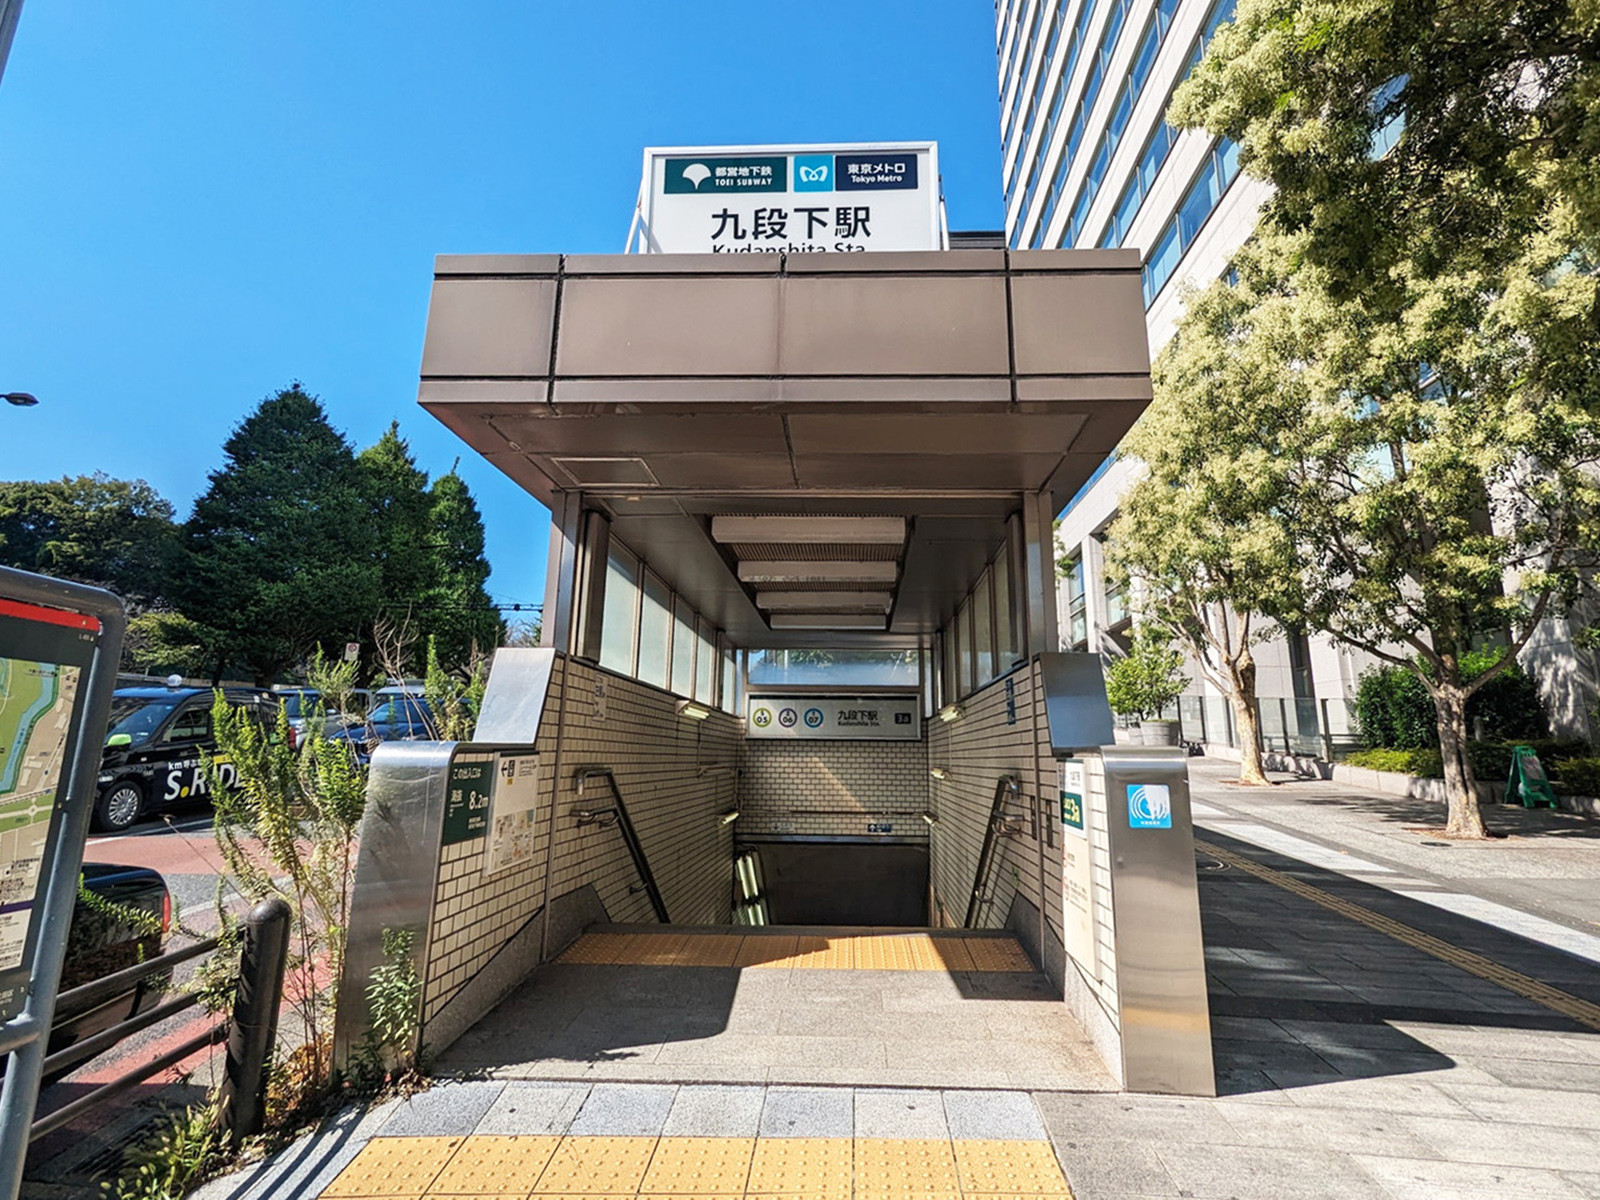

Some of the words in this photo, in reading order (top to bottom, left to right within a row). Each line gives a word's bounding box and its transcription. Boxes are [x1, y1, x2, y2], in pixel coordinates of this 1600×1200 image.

[715, 166, 772, 177] 都営地下鉄
[847, 163, 905, 174] 東京メトロ
[737, 178, 772, 186] SUBWAY
[851, 175, 875, 184] Tokyo
[877, 174, 902, 183] Metro
[711, 206, 871, 240] 九段下駅
[782, 716, 794, 724] 06
[808, 716, 819, 724] 07
[838, 710, 878, 721] 九段下駅
